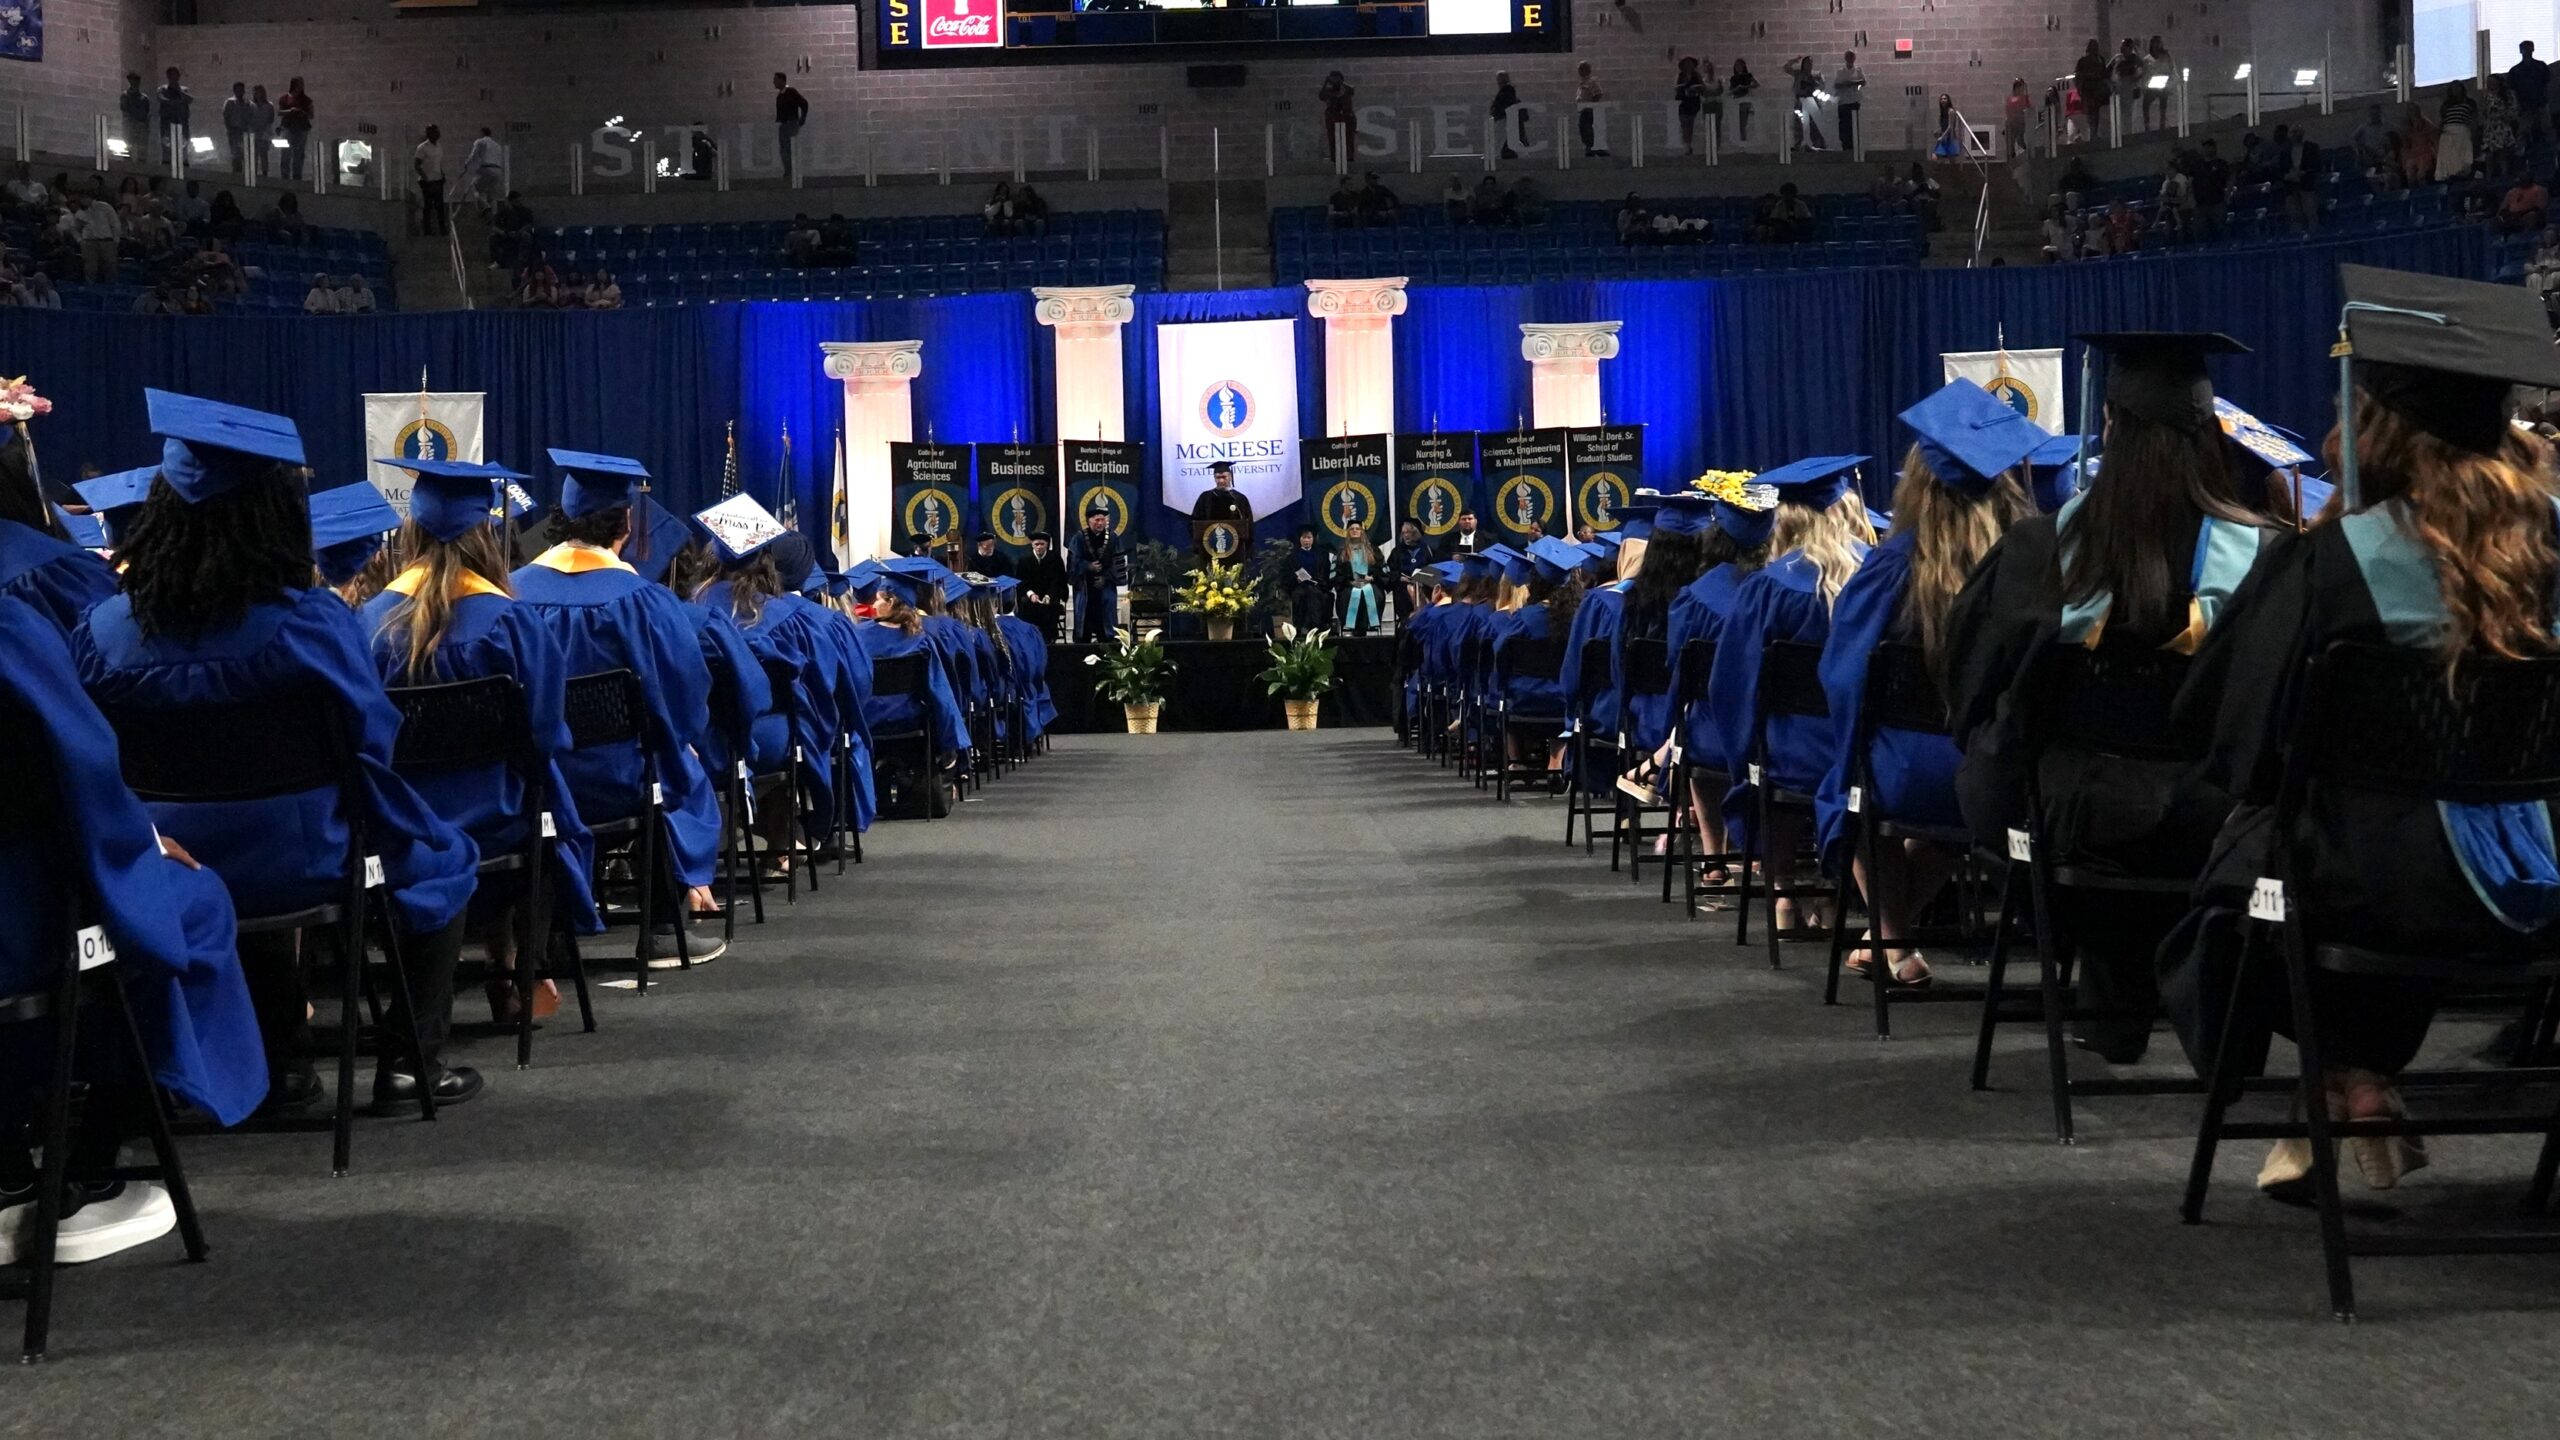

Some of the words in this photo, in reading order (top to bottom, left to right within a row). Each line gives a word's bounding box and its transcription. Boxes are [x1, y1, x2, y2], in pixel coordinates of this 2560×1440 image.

[1523, 4, 1542, 27] E
[930, 15, 993, 37] Coca-Cola
[1905, 85, 1922, 96] 110
[1138, 103, 1158, 114] 109
[592, 113, 1078, 177] STUNT
[1573, 433, 1598, 442] William
[1625, 431, 1635, 440] Sr.
[1176, 439, 1284, 460] McNEESE
[1331, 442, 1351, 450] Collee
[1483, 448, 1516, 457] Science,
[1516, 443, 1561, 455] Engineering
[1611, 443, 1619, 451] of
[1446, 448, 1453, 457] &
[1607, 453, 1633, 462] Studies
[907, 459, 957, 470] Agricultural
[1075, 459, 1130, 475] Education
[1312, 454, 1354, 470] Liberal
[1356, 453, 1381, 467] Arts
[1426, 460, 1470, 470] Professions
[1496, 459, 1502, 467] &
[1504, 456, 1553, 467] Mathematics
[991, 462, 1045, 475] Business
[1180, 466, 1214, 477] STATE
[1233, 463, 1283, 475] IVERSITY
[912, 470, 951, 481] Sciences
